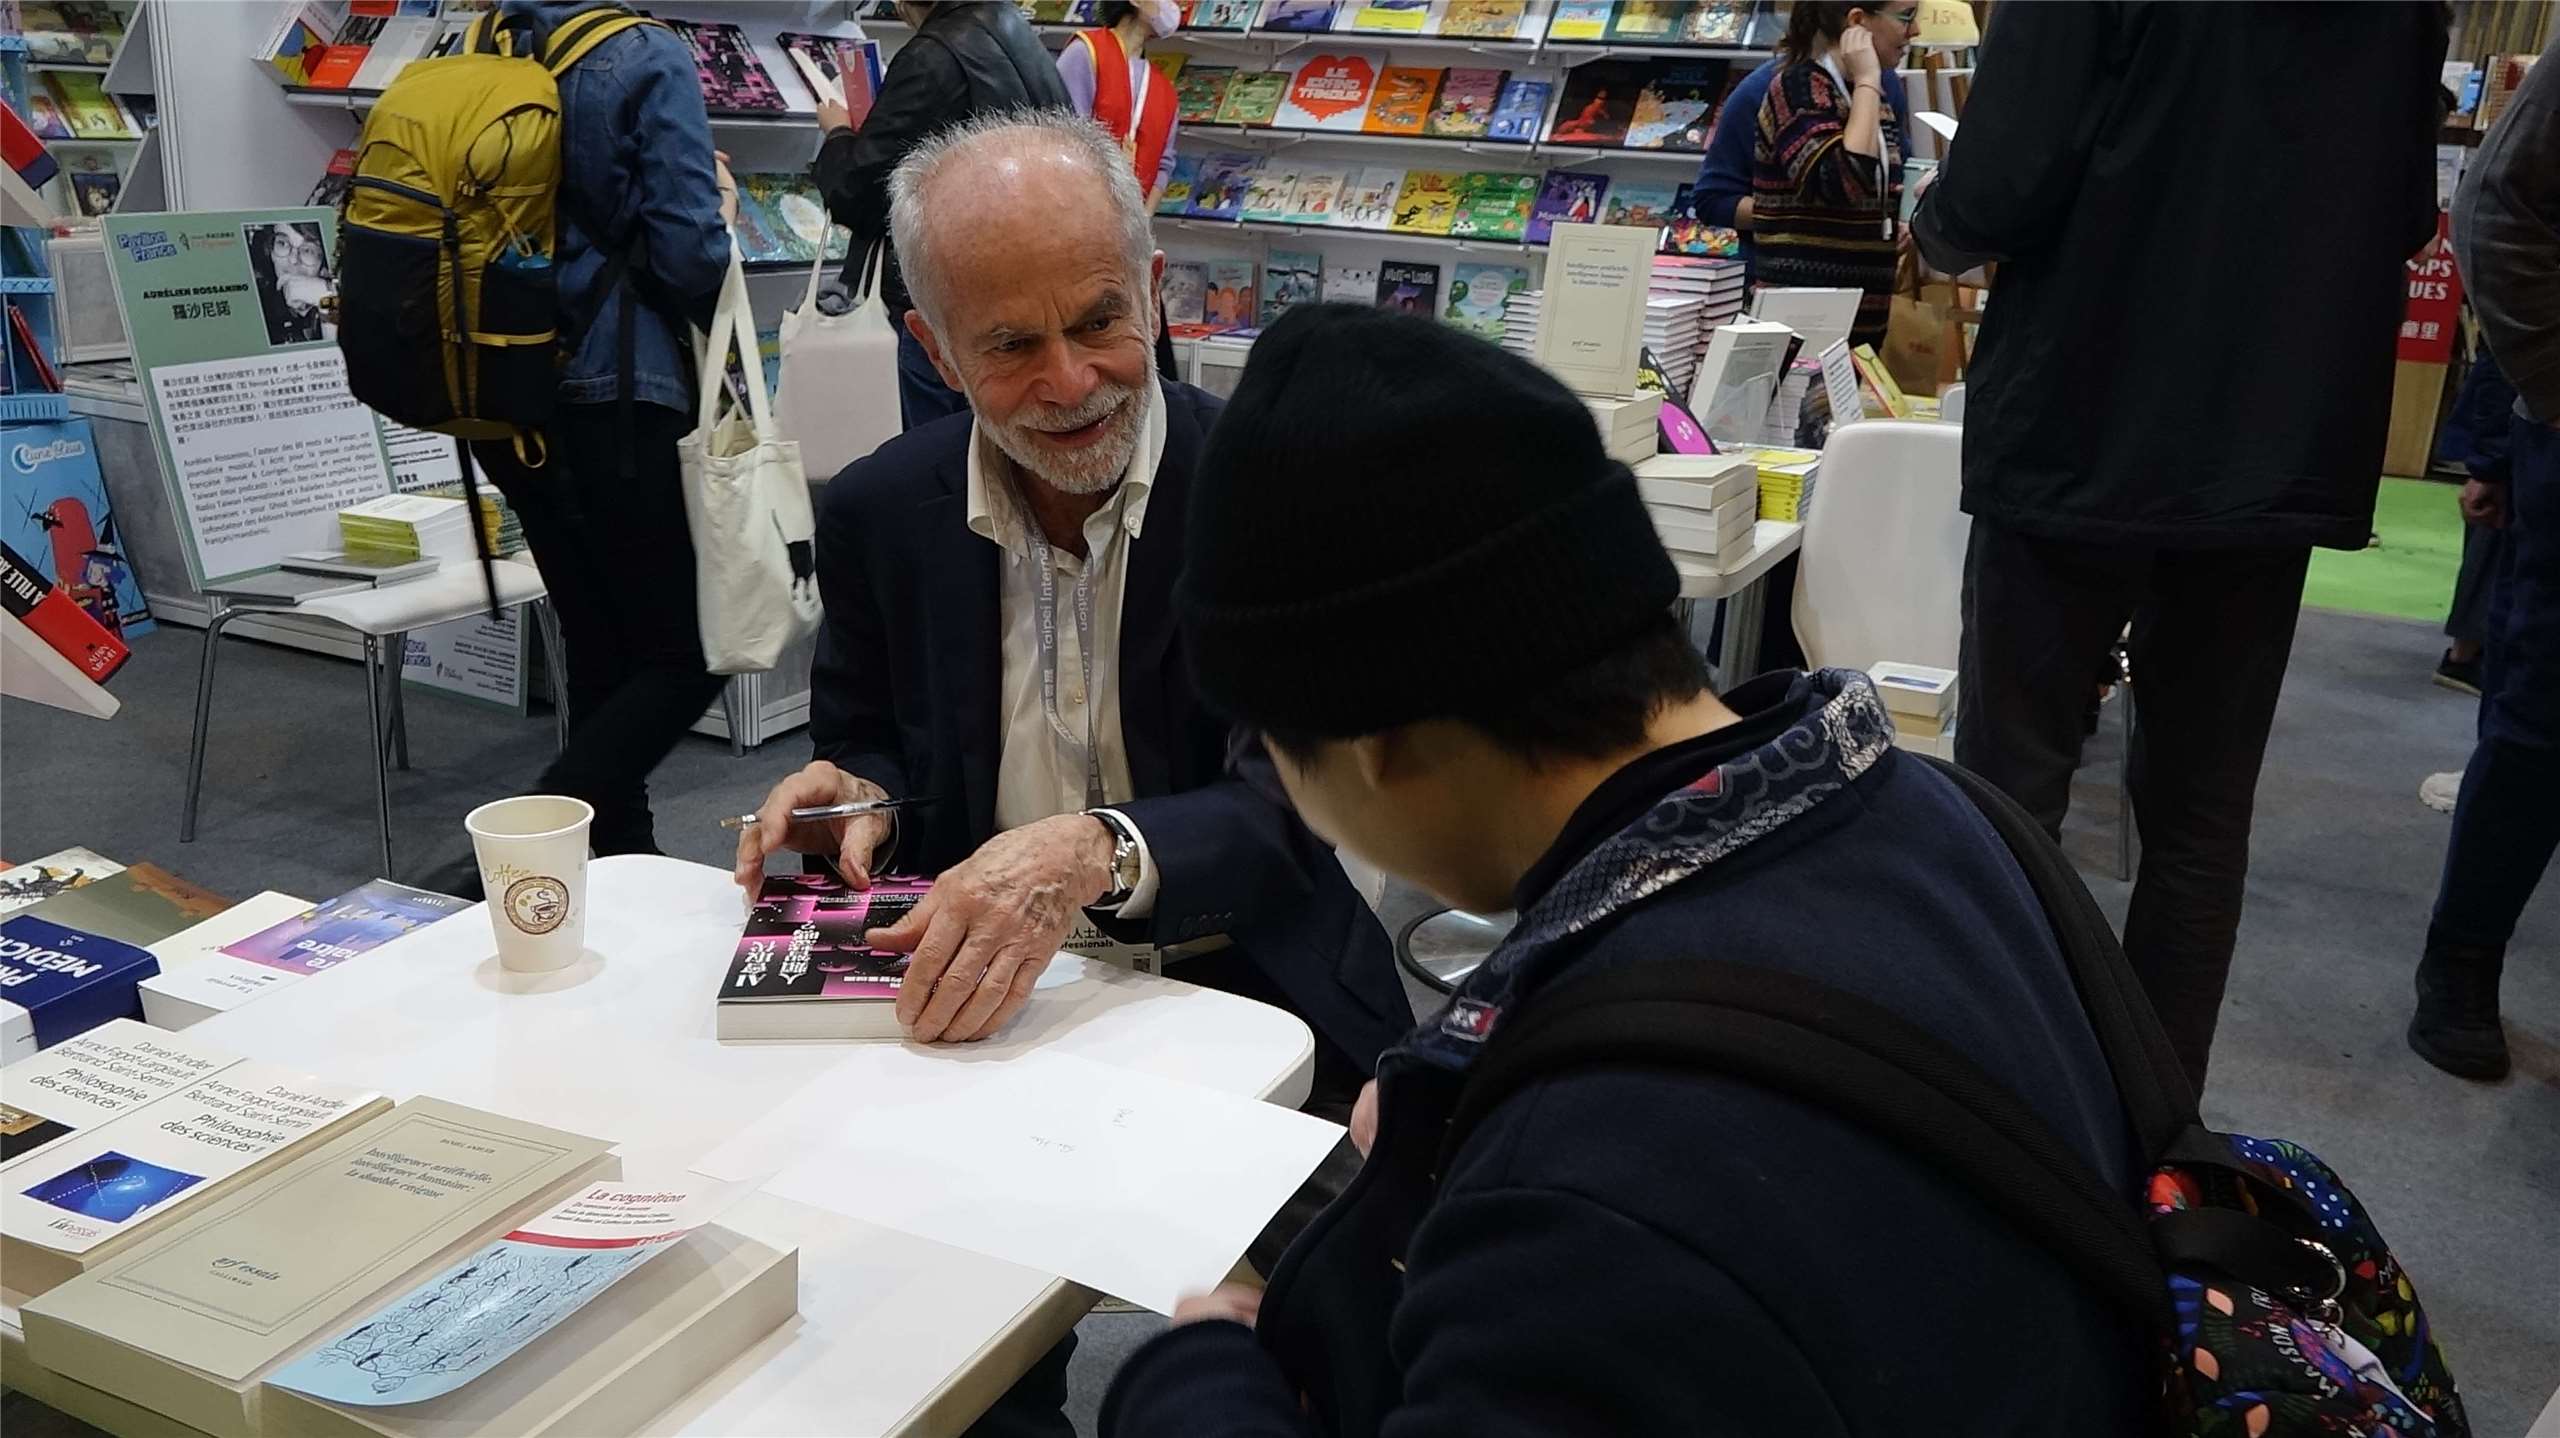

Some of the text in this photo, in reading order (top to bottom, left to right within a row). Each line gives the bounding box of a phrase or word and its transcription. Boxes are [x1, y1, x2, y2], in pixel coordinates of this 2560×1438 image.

[1325, 67, 1350, 77] LE
[132, 244, 176, 262] France
[4, 568, 34, 600] FILLE
[1042, 604, 1055, 652] Taipei
[54, 1046, 175, 1089] Bertrand Saint-Sernin
[72, 1038, 196, 1080] Anne Fagot-Largeault
[134, 1041, 214, 1070] Daniel Andler
[29, 1075, 61, 1089] des
[56, 1083, 122, 1109] sciences
[59, 1067, 148, 1101] Philosophie
[201, 1080, 333, 1120] Anne Fagot-Largeault
[266, 1085, 349, 1110] Daniel Andler
[184, 1089, 312, 1129] Bertrand Saint-Sernin
[160, 1120, 190, 1135] des
[188, 1131, 257, 1152] sciences
[192, 1113, 286, 1144] Philosophie
[351, 1157, 417, 1177] intelligence
[366, 1147, 493, 1184] Intelligence artificielle,
[344, 1169, 445, 1199] la double énigme
[586, 1189, 687, 1205] La cognition
[239, 1263, 281, 1282] essais
